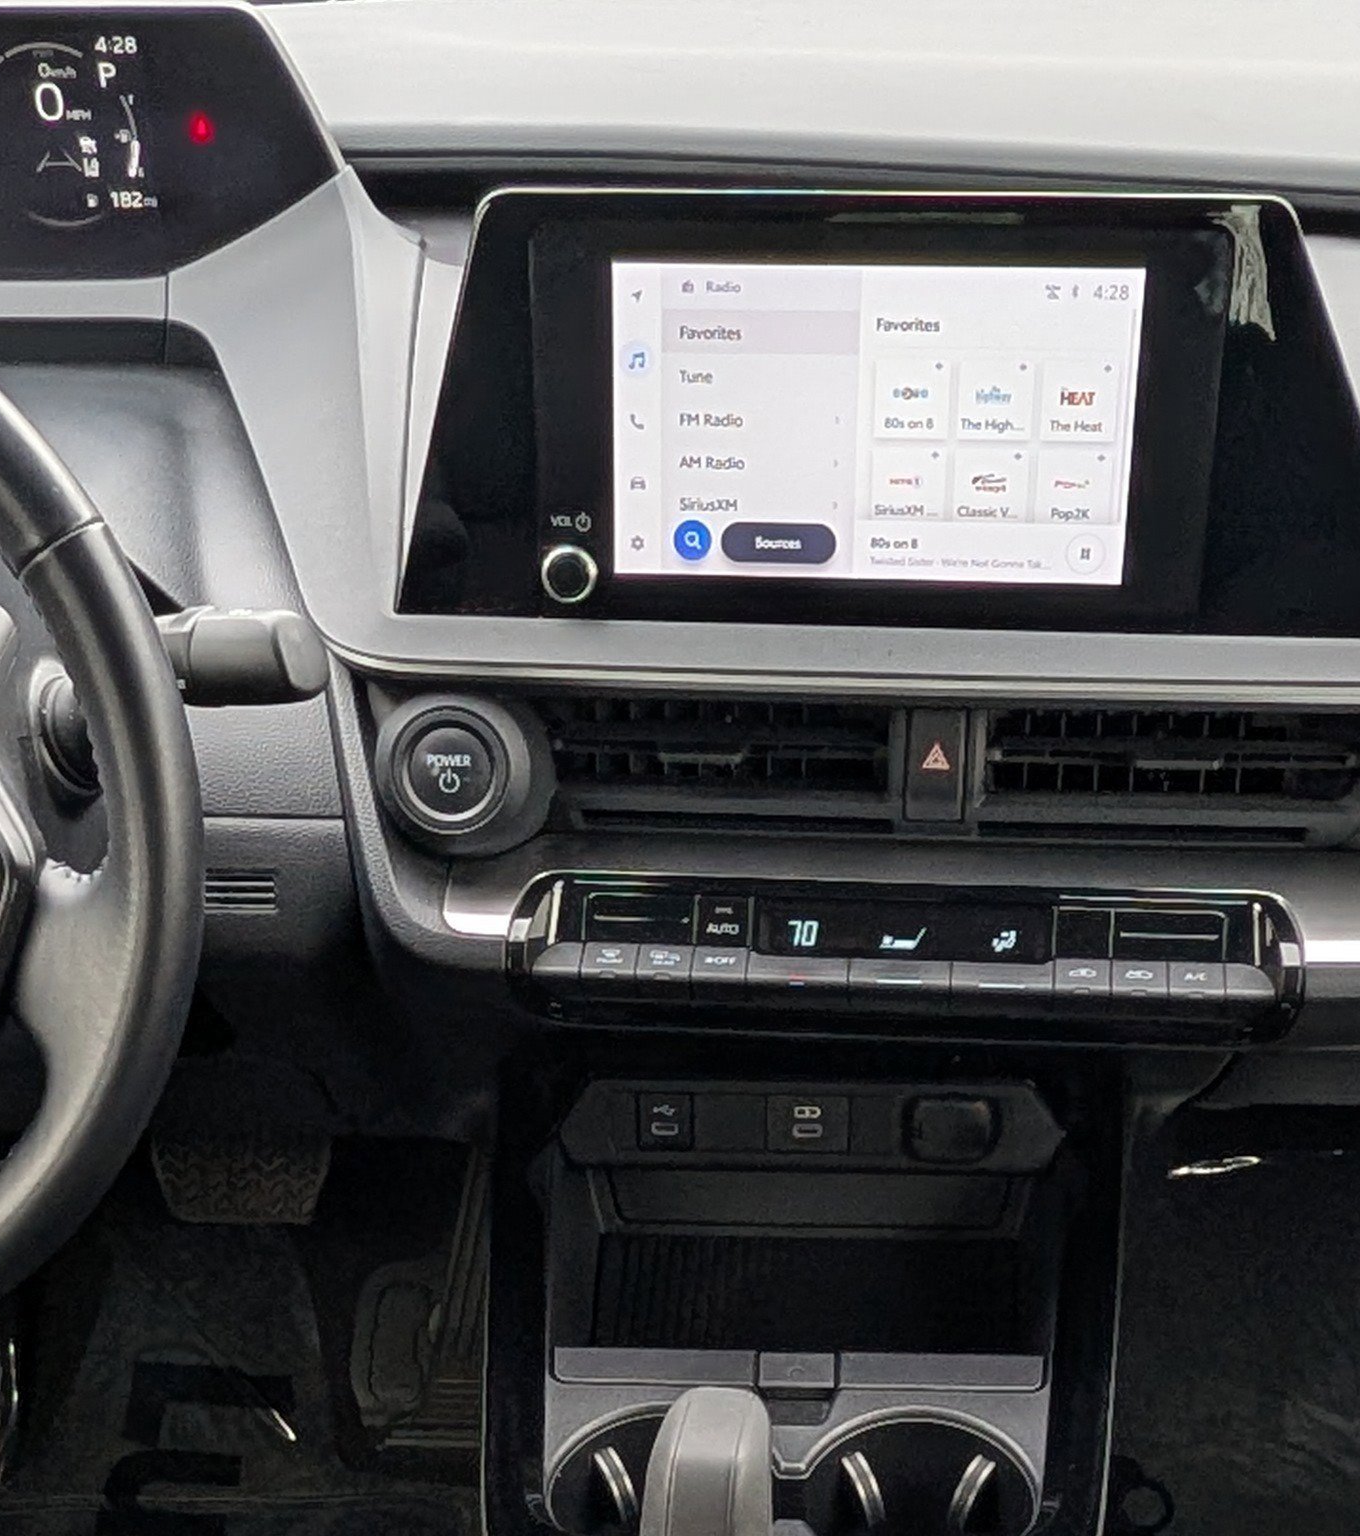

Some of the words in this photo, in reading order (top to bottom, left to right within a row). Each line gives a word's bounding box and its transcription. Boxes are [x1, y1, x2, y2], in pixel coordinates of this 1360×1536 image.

[94, 36, 138, 54] 4:28
[98, 61, 117, 88] P
[34, 82, 64, 121] 0
[66, 110, 92, 121] MPH
[110, 191, 144, 208] 182
[706, 280, 741, 294] Radio
[1093, 284, 1130, 300] 4:28
[876, 317, 940, 332] Favorites
[679, 325, 742, 341] Favorites
[679, 369, 714, 384] Tune
[1060, 391, 1096, 406] HEAT
[679, 412, 700, 427] FM
[703, 412, 744, 427] Radio
[960, 417, 982, 431] The
[1049, 419, 1071, 432] The
[1074, 419, 1102, 432] Heat
[679, 457, 701, 470] AM
[705, 456, 745, 471] Radio
[679, 497, 738, 512] SiriusXM
[874, 503, 924, 516] SiriusXM
[957, 506, 998, 519] Classic
[1050, 507, 1090, 522] Pop2K
[754, 536, 802, 550] Sources
[870, 537, 891, 549] 80s
[893, 539, 909, 549] on
[426, 753, 472, 768] POWER
[706, 922, 740, 936] AUTO
[788, 920, 819, 947] 70
[1184, 971, 1208, 982] A/C
